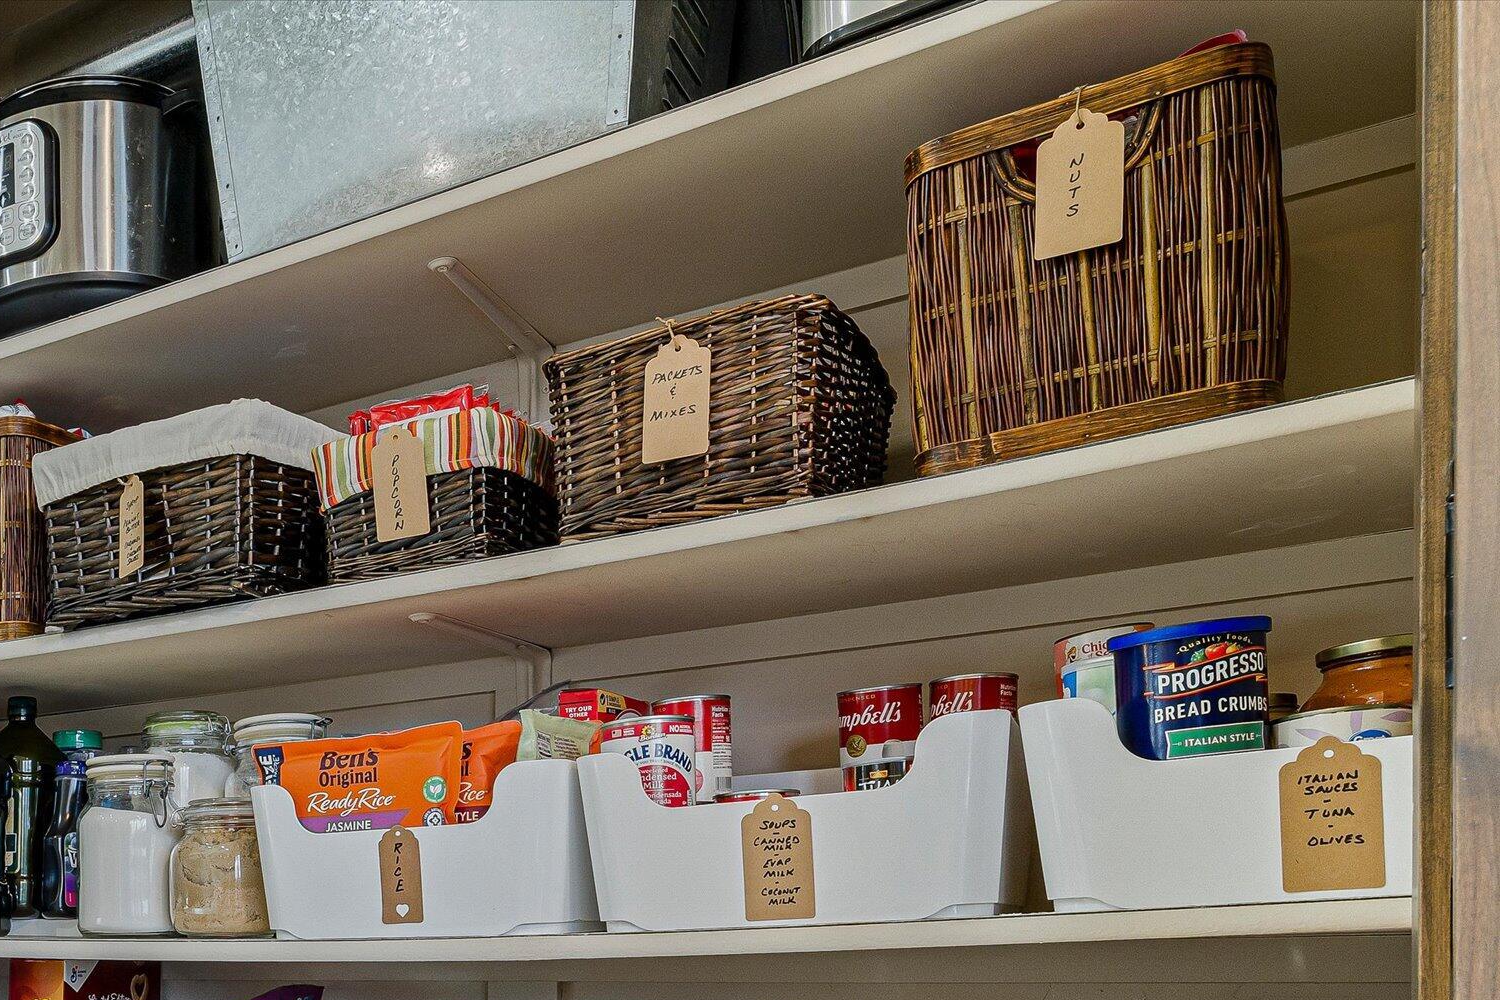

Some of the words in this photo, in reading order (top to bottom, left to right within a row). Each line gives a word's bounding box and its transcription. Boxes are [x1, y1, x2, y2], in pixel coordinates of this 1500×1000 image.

[1066, 152, 1085, 218] NUTS
[651, 365, 703, 385] PACKETS
[649, 404, 696, 422] MIXES
[391, 454, 404, 531] POPCORN
[1157, 651, 1265, 695] PROGRESSO
[565, 706, 577, 714] TRY
[1154, 699, 1211, 724] BREAD
[1217, 695, 1268, 713] CRUMBS
[1184, 735, 1227, 747] ITALIAN
[1229, 732, 1255, 743] STYLE
[319, 747, 380, 771] Ben's
[654, 743, 693, 773] BRAND
[318, 767, 378, 788] Original
[1297, 769, 1359, 785] ITALIAN
[1304, 782, 1358, 796] SAUCES
[1304, 806, 1355, 820] TUNA
[325, 819, 372, 832] JASMINE
[759, 819, 796, 830] SOUPS
[753, 836, 800, 847] CANNED
[1307, 833, 1365, 847] OLIVES
[763, 843, 792, 852] MILK
[392, 841, 405, 894] RICE
[762, 857, 792, 869] EVAP
[763, 868, 795, 879] MILK
[761, 886, 801, 897] COCONUT
[768, 896, 797, 906] MILK
